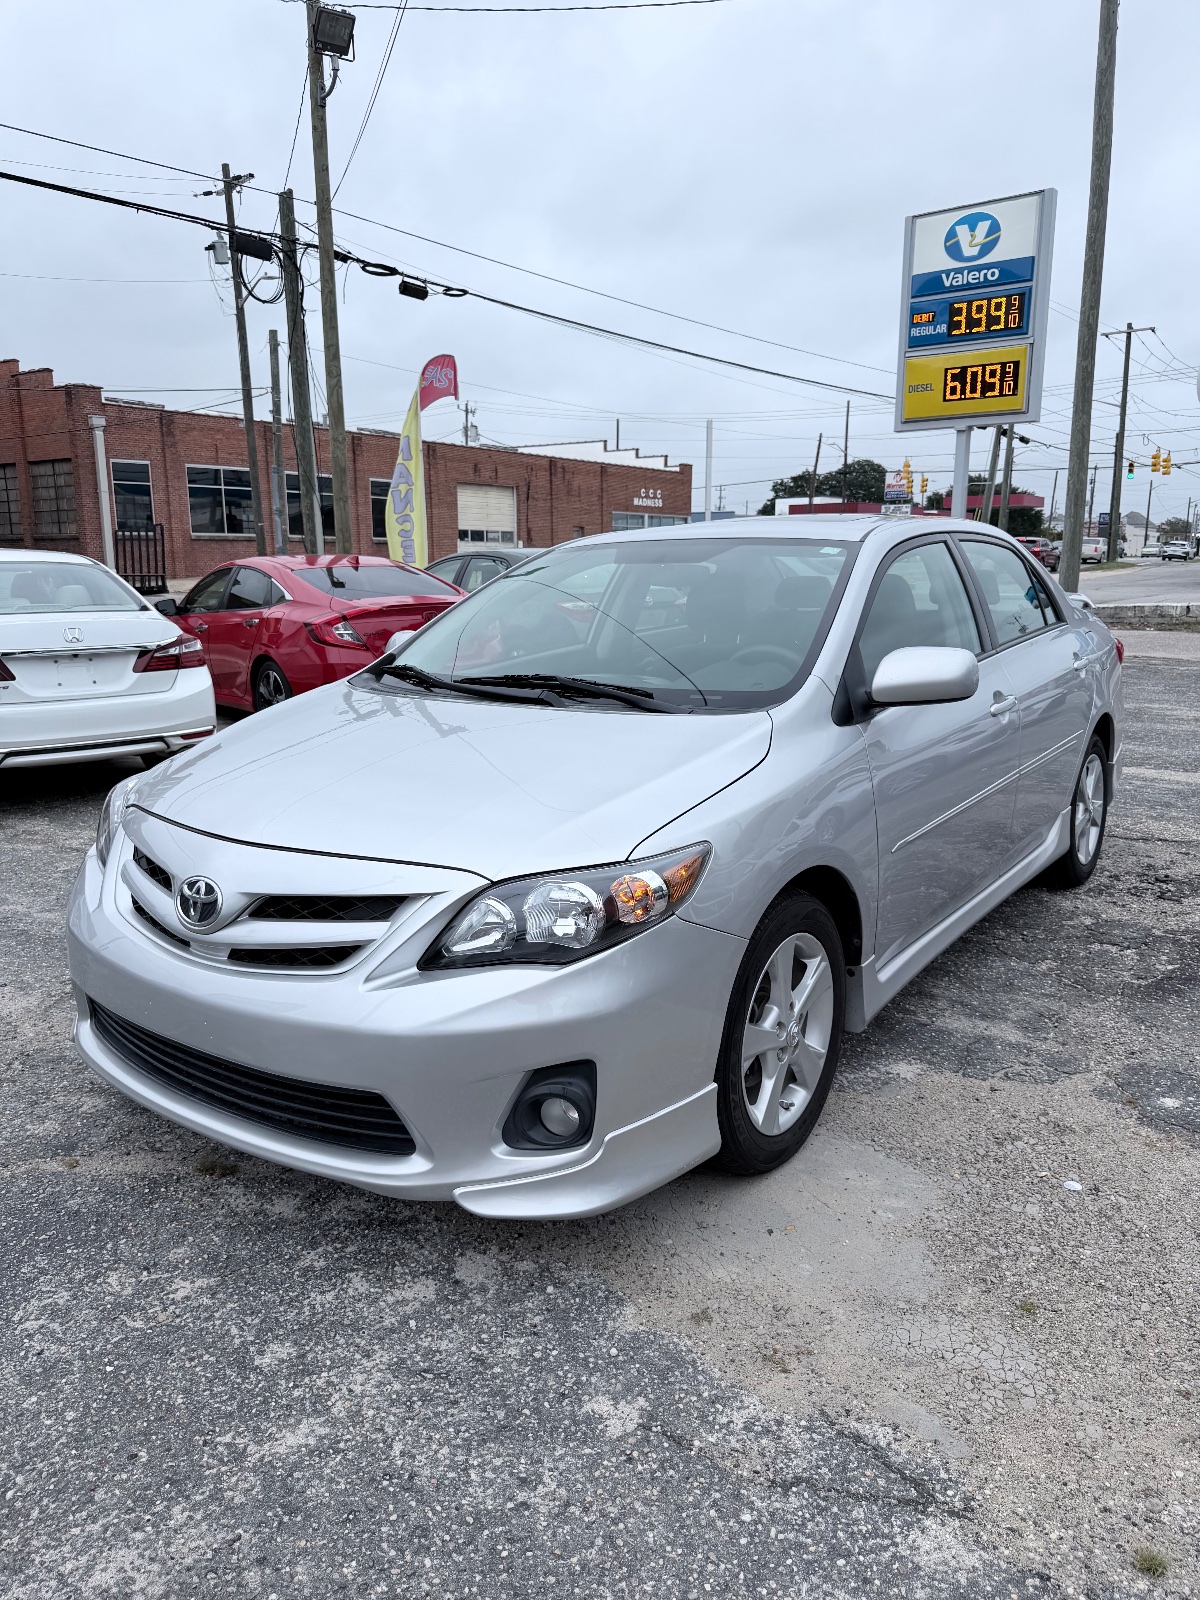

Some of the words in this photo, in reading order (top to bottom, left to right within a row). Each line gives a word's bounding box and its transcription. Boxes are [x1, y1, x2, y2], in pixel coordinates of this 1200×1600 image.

[941, 267, 999, 287] Valero
[912, 312, 935, 323] DEBIT
[951, 297, 1007, 335] 3.99
[910, 323, 947, 337] REGULAR
[908, 382, 935, 394] DIESEL
[945, 364, 1002, 402] 6.09
[633, 497, 663, 507] MADNESS
